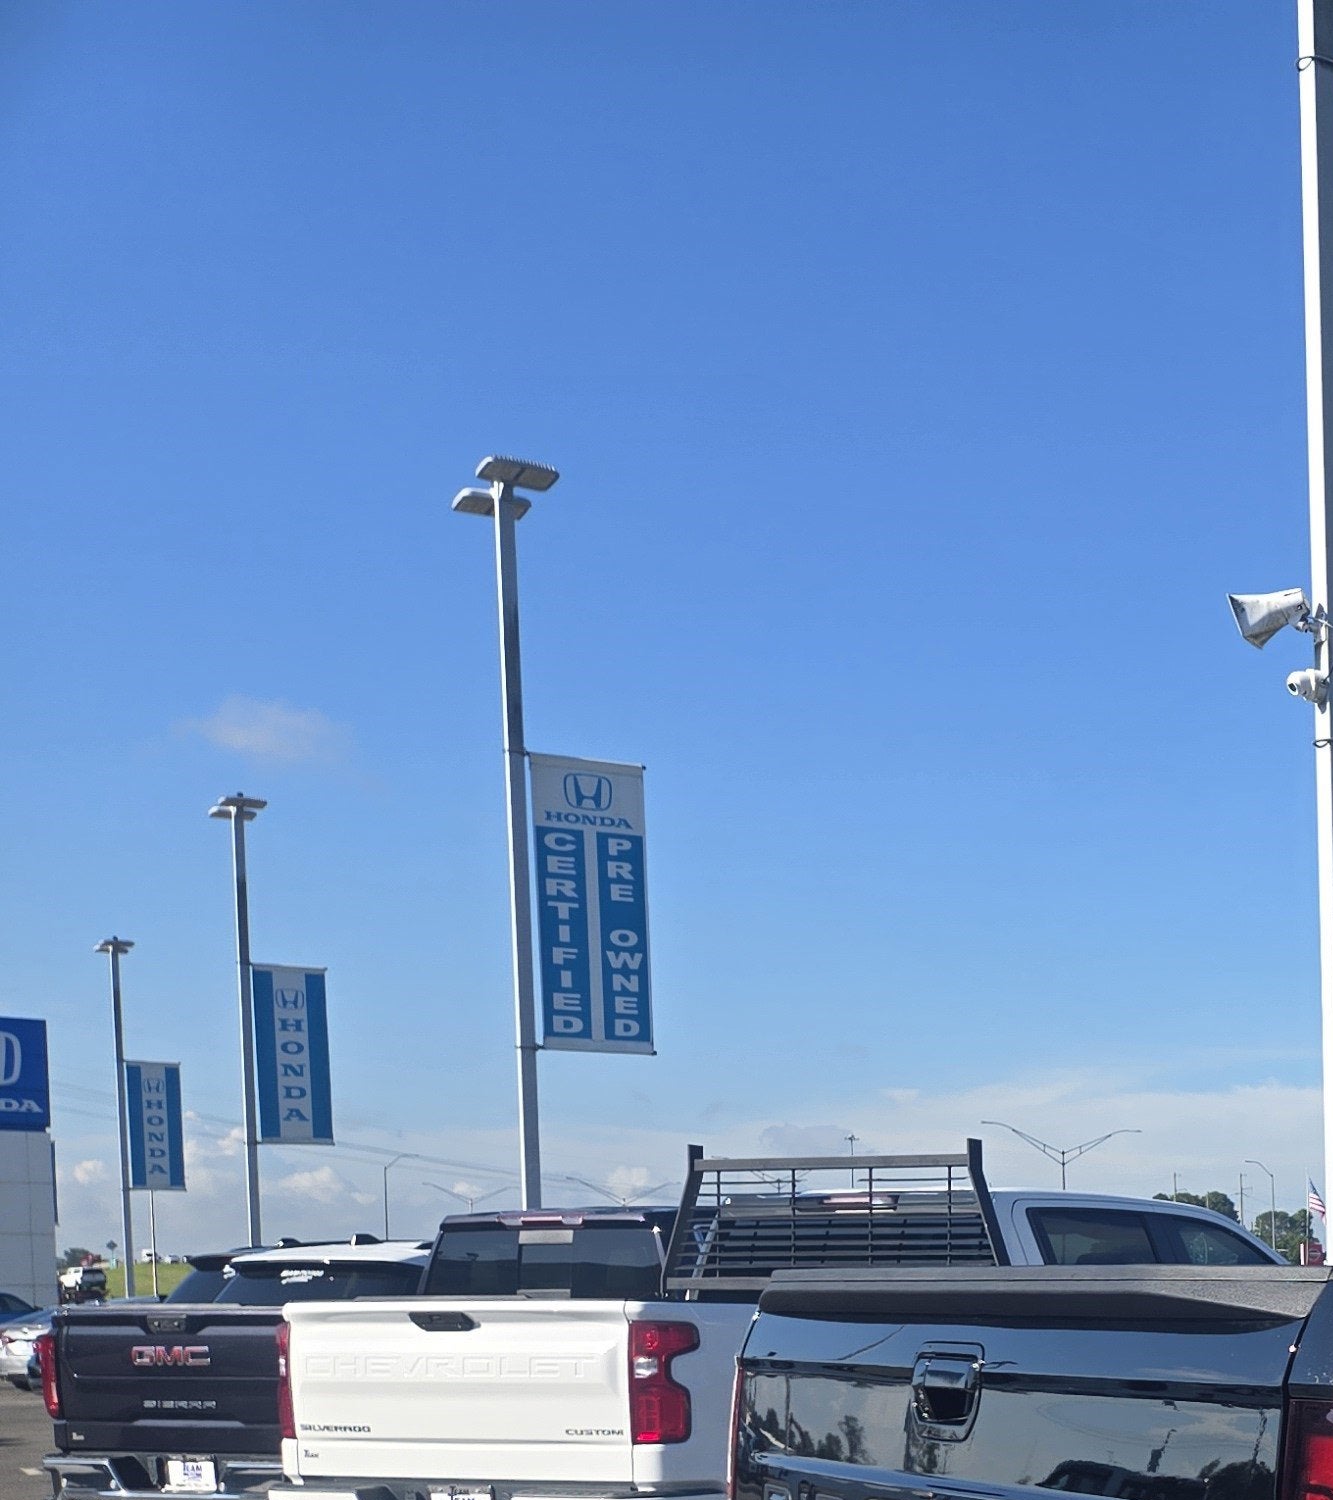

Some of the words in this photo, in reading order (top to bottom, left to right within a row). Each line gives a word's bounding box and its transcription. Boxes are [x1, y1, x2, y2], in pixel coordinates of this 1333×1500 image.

[544, 810, 634, 830] HONDA
[606, 838, 635, 903] PRE
[543, 832, 585, 1034] CERTIFIED
[605, 929, 643, 1037] OWNED
[278, 1017, 310, 1122] HONDA
[145, 1099, 168, 1175] HONDA
[131, 1346, 211, 1366] GMC
[304, 1354, 599, 1379] CHEVROLET
[300, 1423, 372, 1433] SILVERADO
[565, 1428, 624, 1436] CUSTOM
